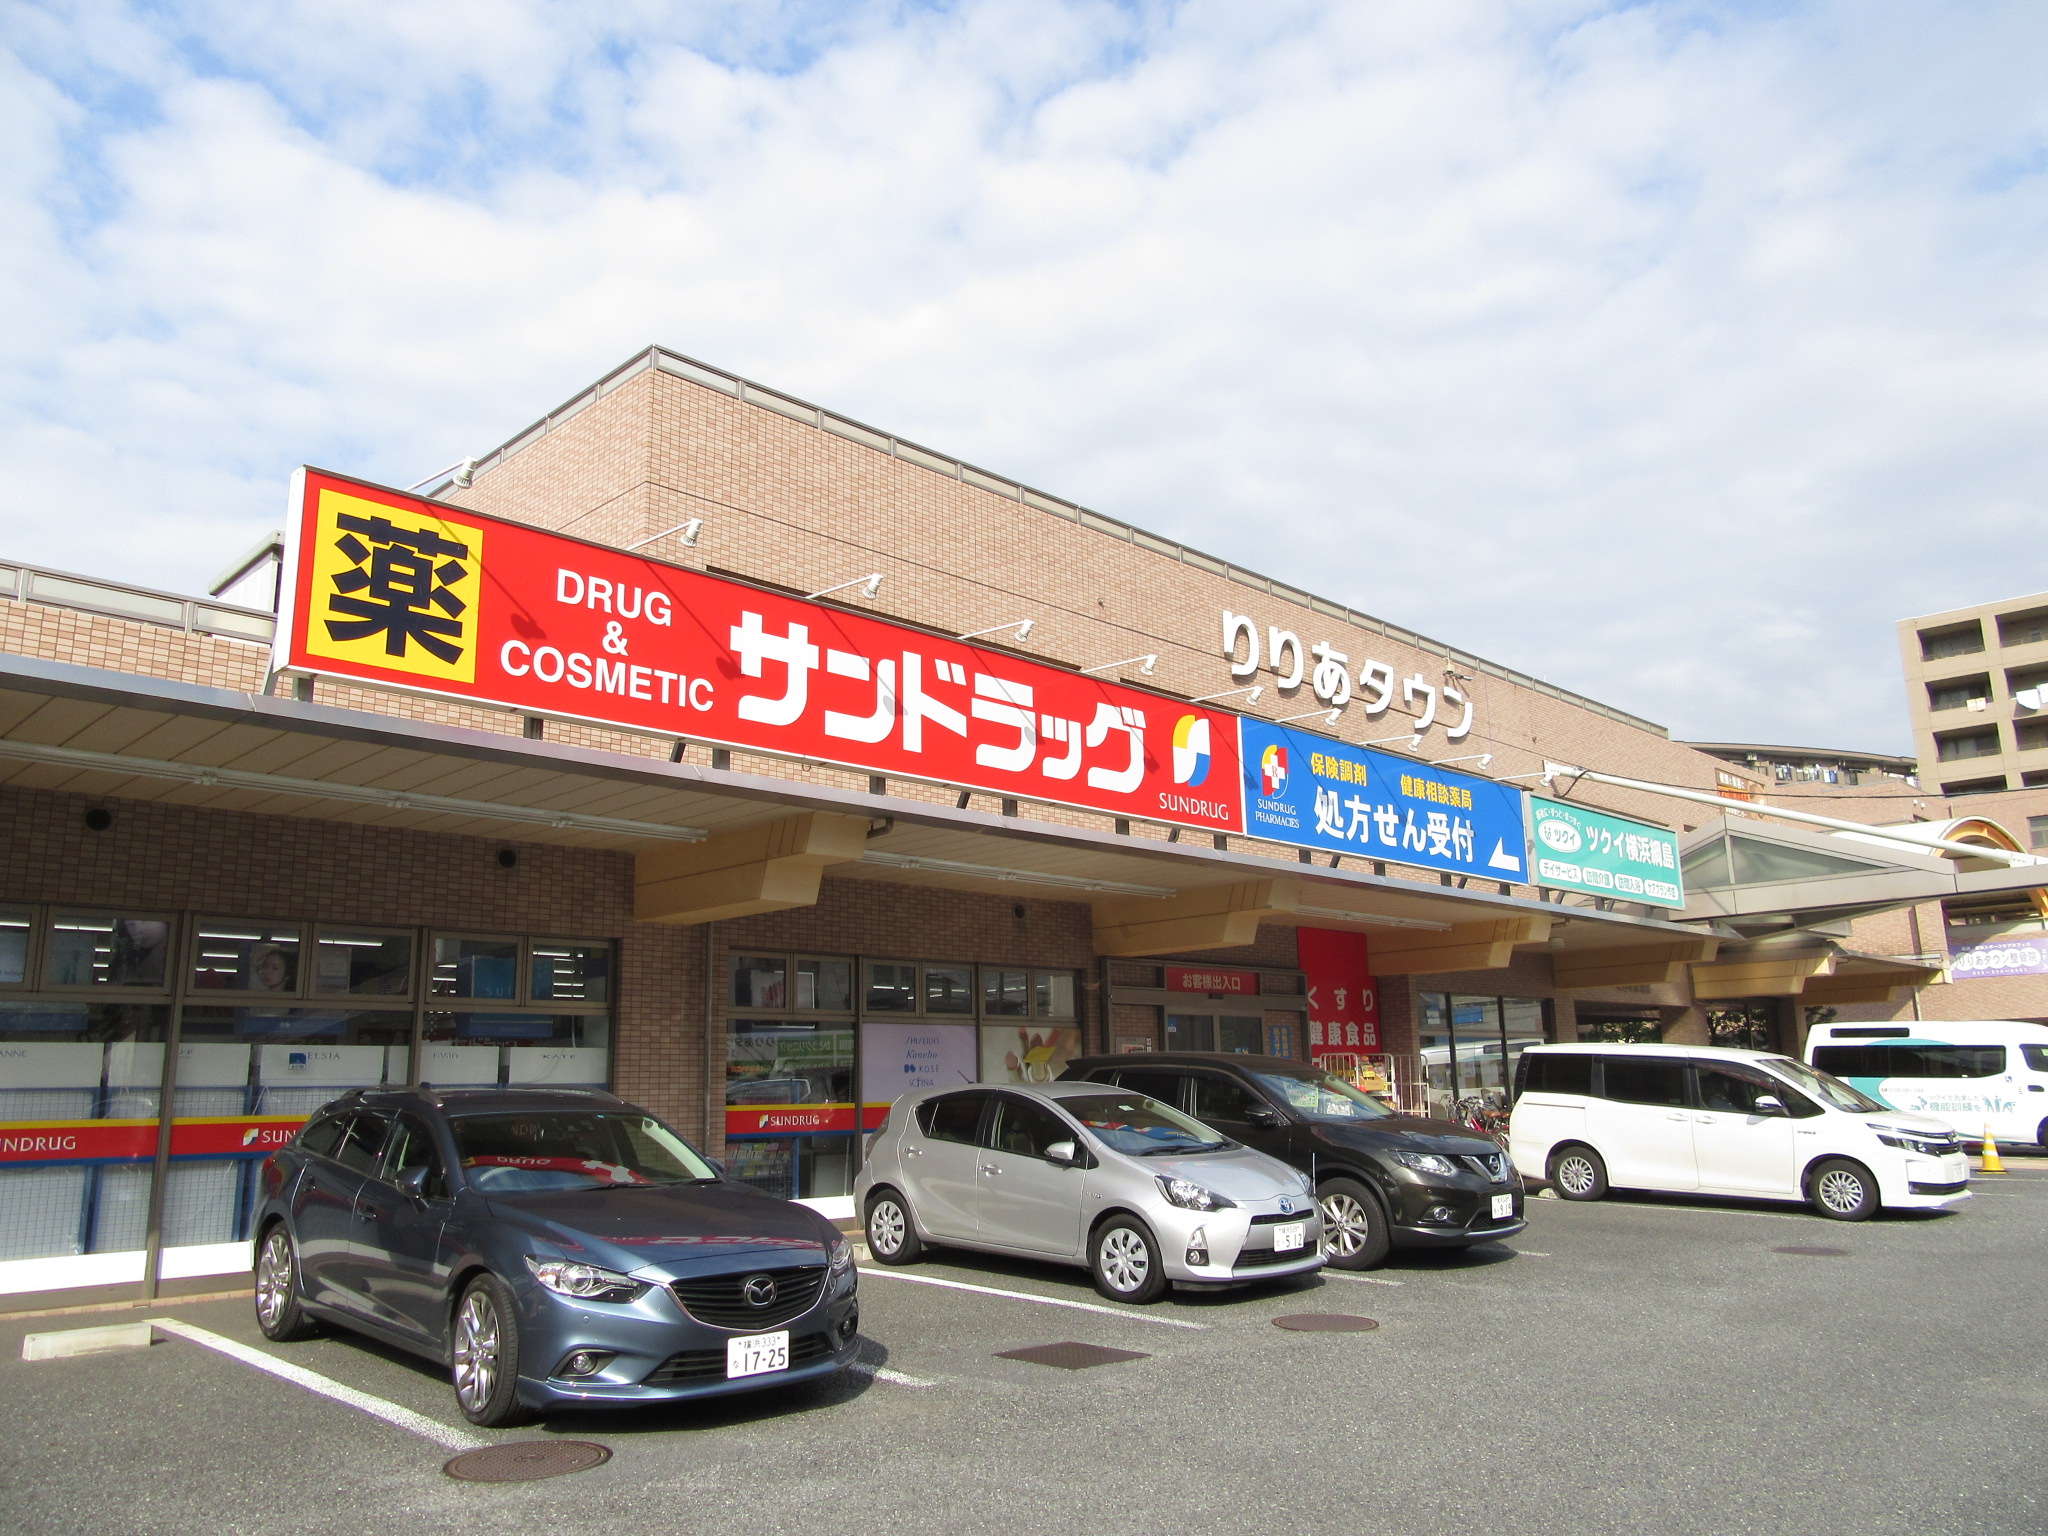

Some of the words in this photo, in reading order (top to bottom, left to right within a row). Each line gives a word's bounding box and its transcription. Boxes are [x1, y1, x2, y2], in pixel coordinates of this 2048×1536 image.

[323, 511, 469, 665] 薬
[556, 567, 673, 628] DRUG
[601, 620, 628, 657] &
[499, 639, 715, 712] COSMETIC
[1222, 609, 1473, 739] りりあタウン
[729, 610, 1146, 794] サンドラッグ
[1310, 752, 1368, 787] 保険調剤
[1400, 773, 1473, 811] 健康相談薬局
[1158, 791, 1229, 821] SUNDRUG
[1257, 798, 1297, 815] SUNDRUG
[1255, 810, 1300, 829] PHARMACIES
[1313, 785, 1475, 863] 処方せん受付
[1553, 828, 1576, 846] ツクイ
[1585, 825, 1675, 870] ツクイ横浜綱島
[1543, 862, 1578, 880] デイサービス
[1182, 972, 1241, 991] お客様出入口
[1308, 986, 1374, 1012] くすり
[905, 1036, 939, 1045] SHISEIDO
[1310, 1021, 1377, 1047] 健康食品
[307, 1052, 341, 1060] ELSIA
[906, 1050, 938, 1059] Kanebo
[770, 1115, 820, 1126] SUNDRUG
[0, 1136, 76, 1152] NDRUG
[744, 1347, 786, 1372] 17-25
